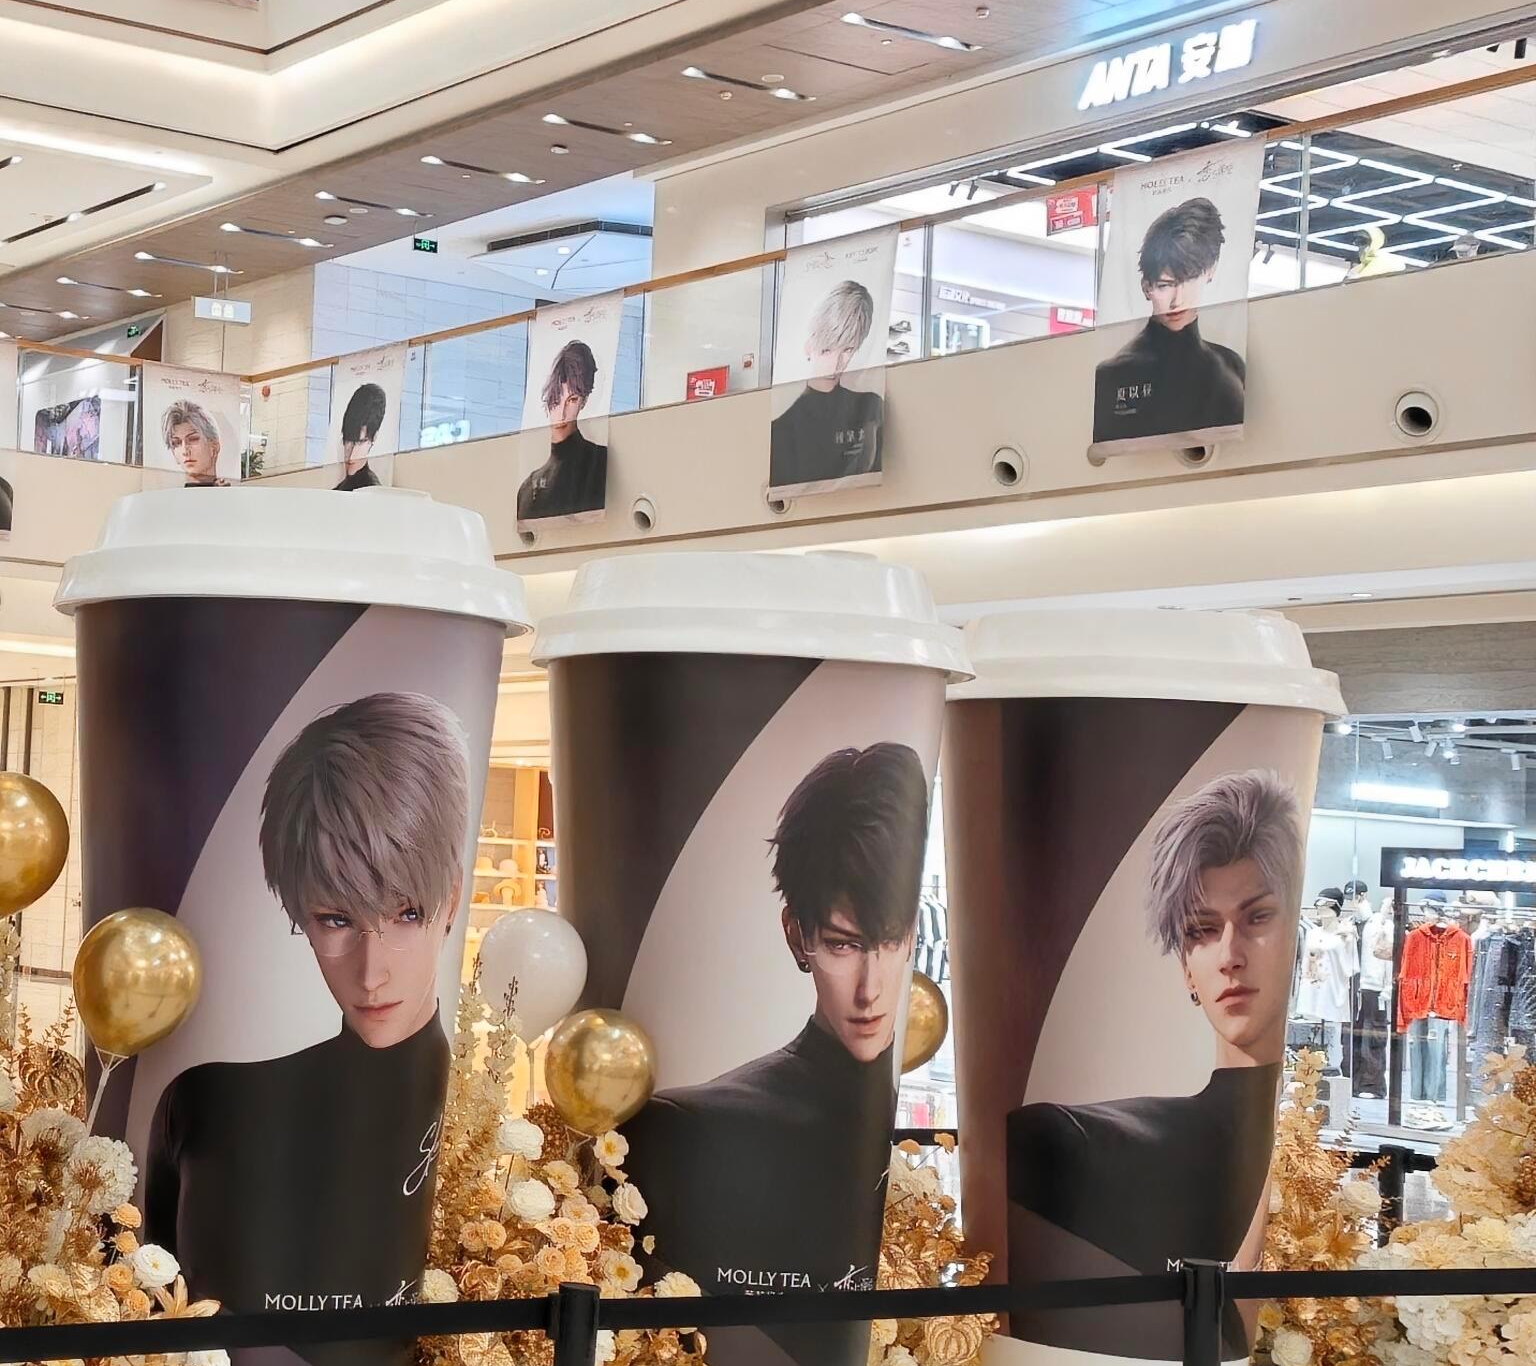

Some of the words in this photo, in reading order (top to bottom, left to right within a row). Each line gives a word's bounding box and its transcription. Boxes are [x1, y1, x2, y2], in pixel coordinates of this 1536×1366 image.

[1077, 42, 1173, 111] ANTA
[717, 1267, 777, 1287] MOLLY
[780, 1271, 812, 1289] TEA
[264, 1292, 327, 1312] MOLLY
[331, 1293, 363, 1310] TEA
